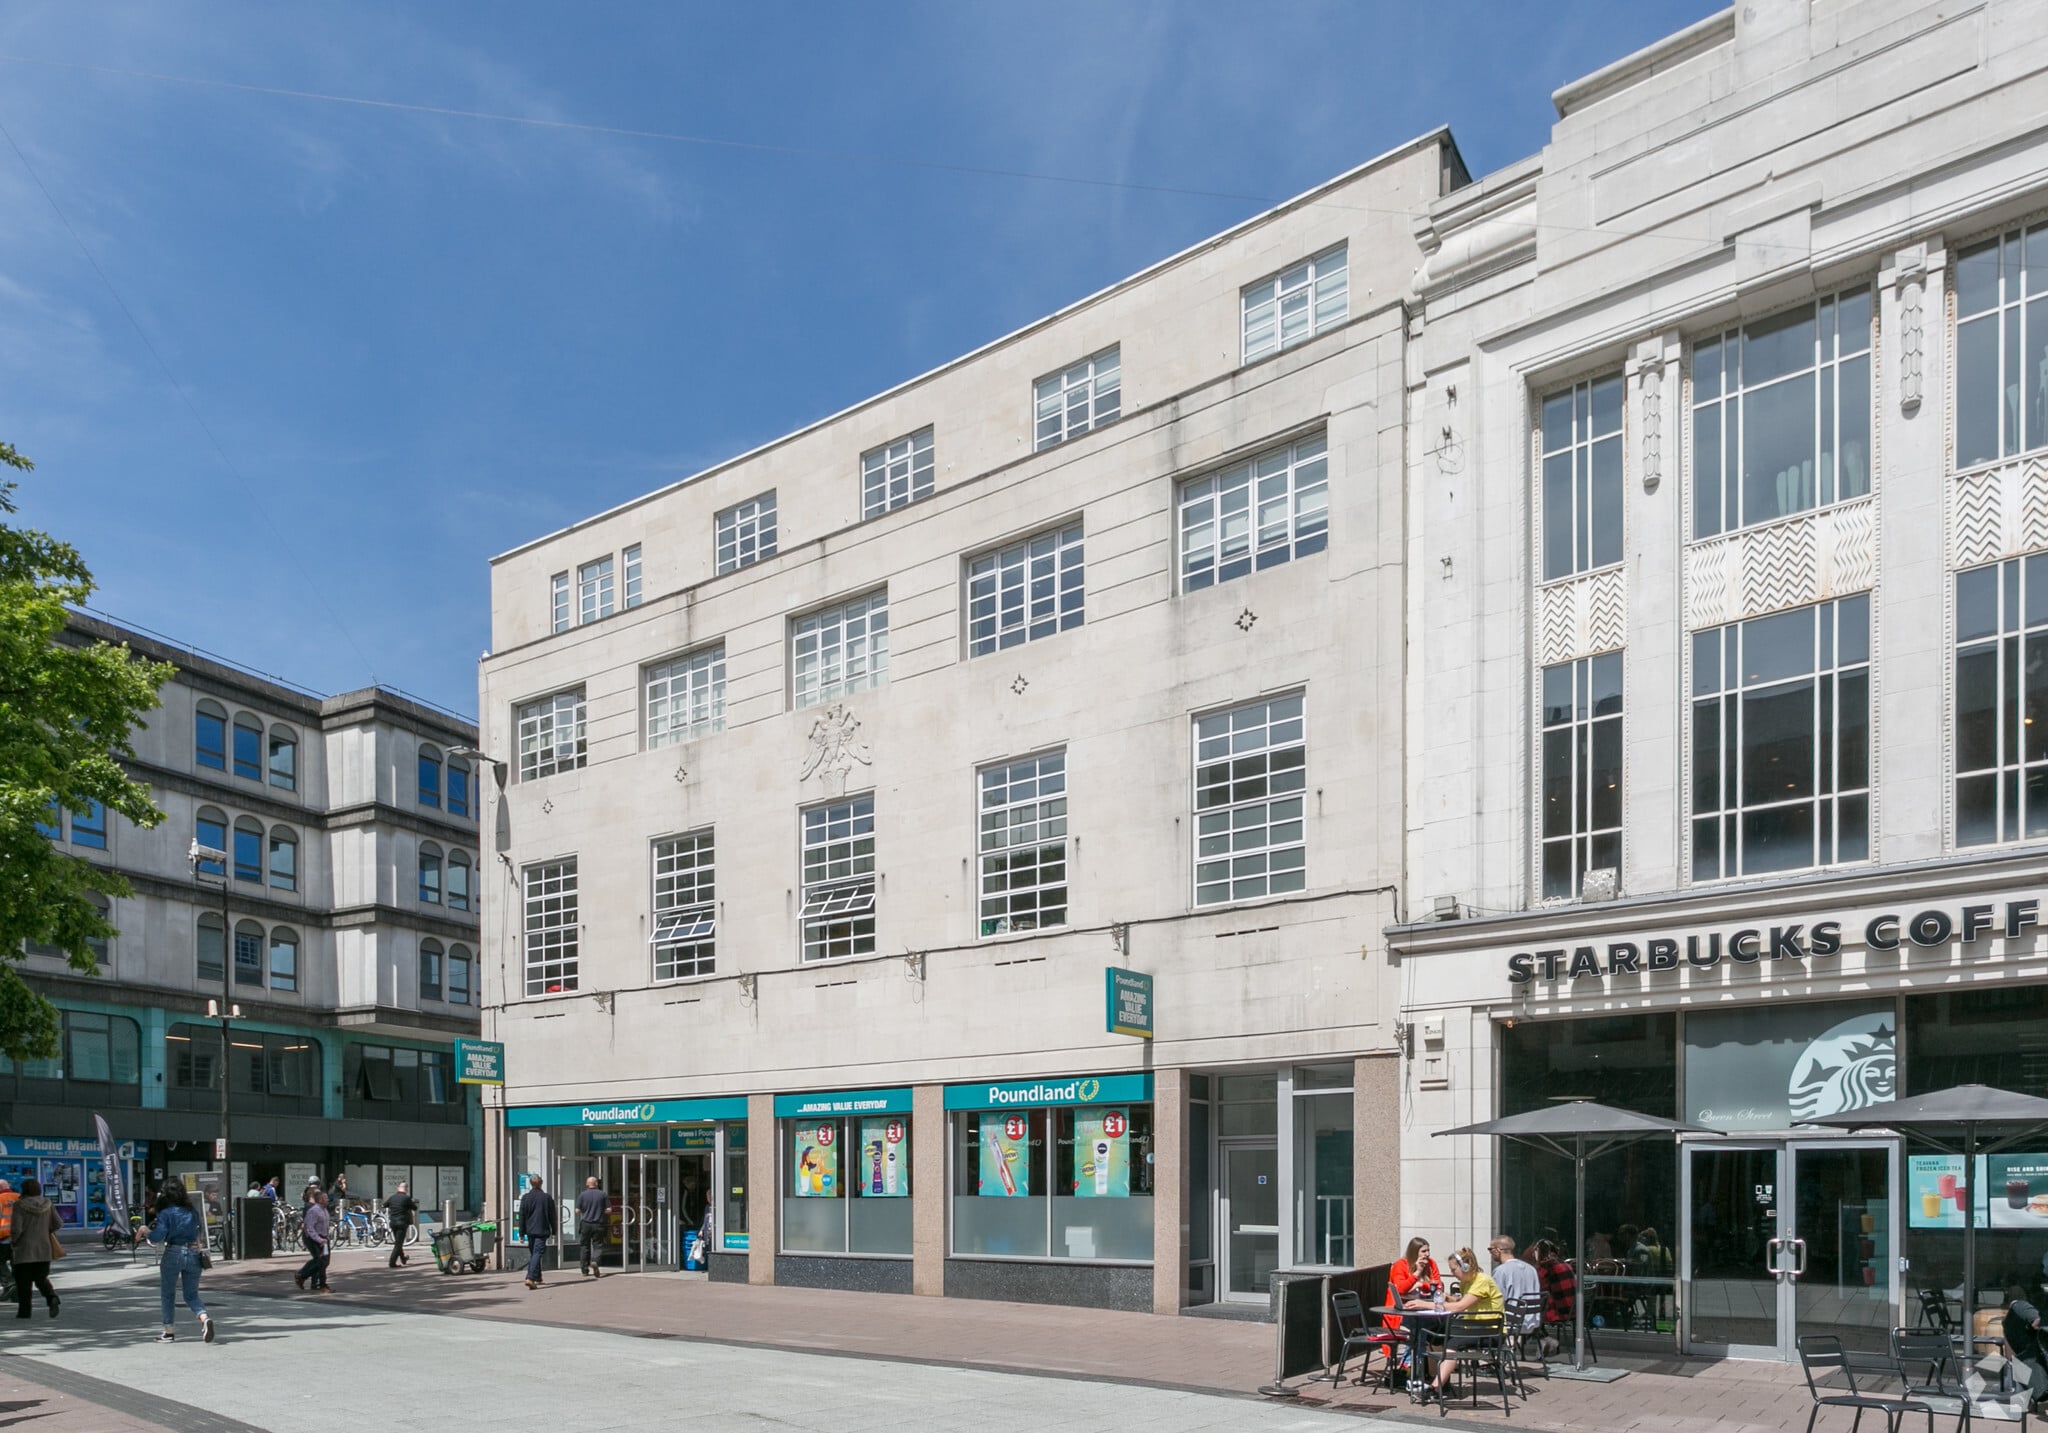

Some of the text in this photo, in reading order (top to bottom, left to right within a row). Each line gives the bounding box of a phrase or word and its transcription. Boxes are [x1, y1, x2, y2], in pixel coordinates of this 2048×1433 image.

[1508, 899, 2040, 984] STARBUCKS COFF
[1115, 974, 1144, 989] Poundland
[1120, 989, 1147, 1005] AMAZING
[1124, 1000, 1143, 1014] VALUE
[1119, 1011, 1148, 1026] EVERYDAY
[462, 1043, 493, 1053] Poundland
[467, 1053, 497, 1063] AMAZING
[472, 1060, 493, 1070] VALUE
[465, 1067, 498, 1078] EVERYDAY
[989, 1083, 1075, 1104] Poundland
[832, 1101, 853, 1111] VALUE
[854, 1099, 888, 1110] EVERYDAY
[582, 1105, 639, 1121] Poundland
[1697, 1107, 1773, 1123] Queen Street
[887, 1122, 902, 1138] £1
[1006, 1119, 1024, 1135] £1
[1105, 1115, 1124, 1133] £1
[818, 1126, 833, 1141] £1
[24, 1138, 63, 1150] Phone
